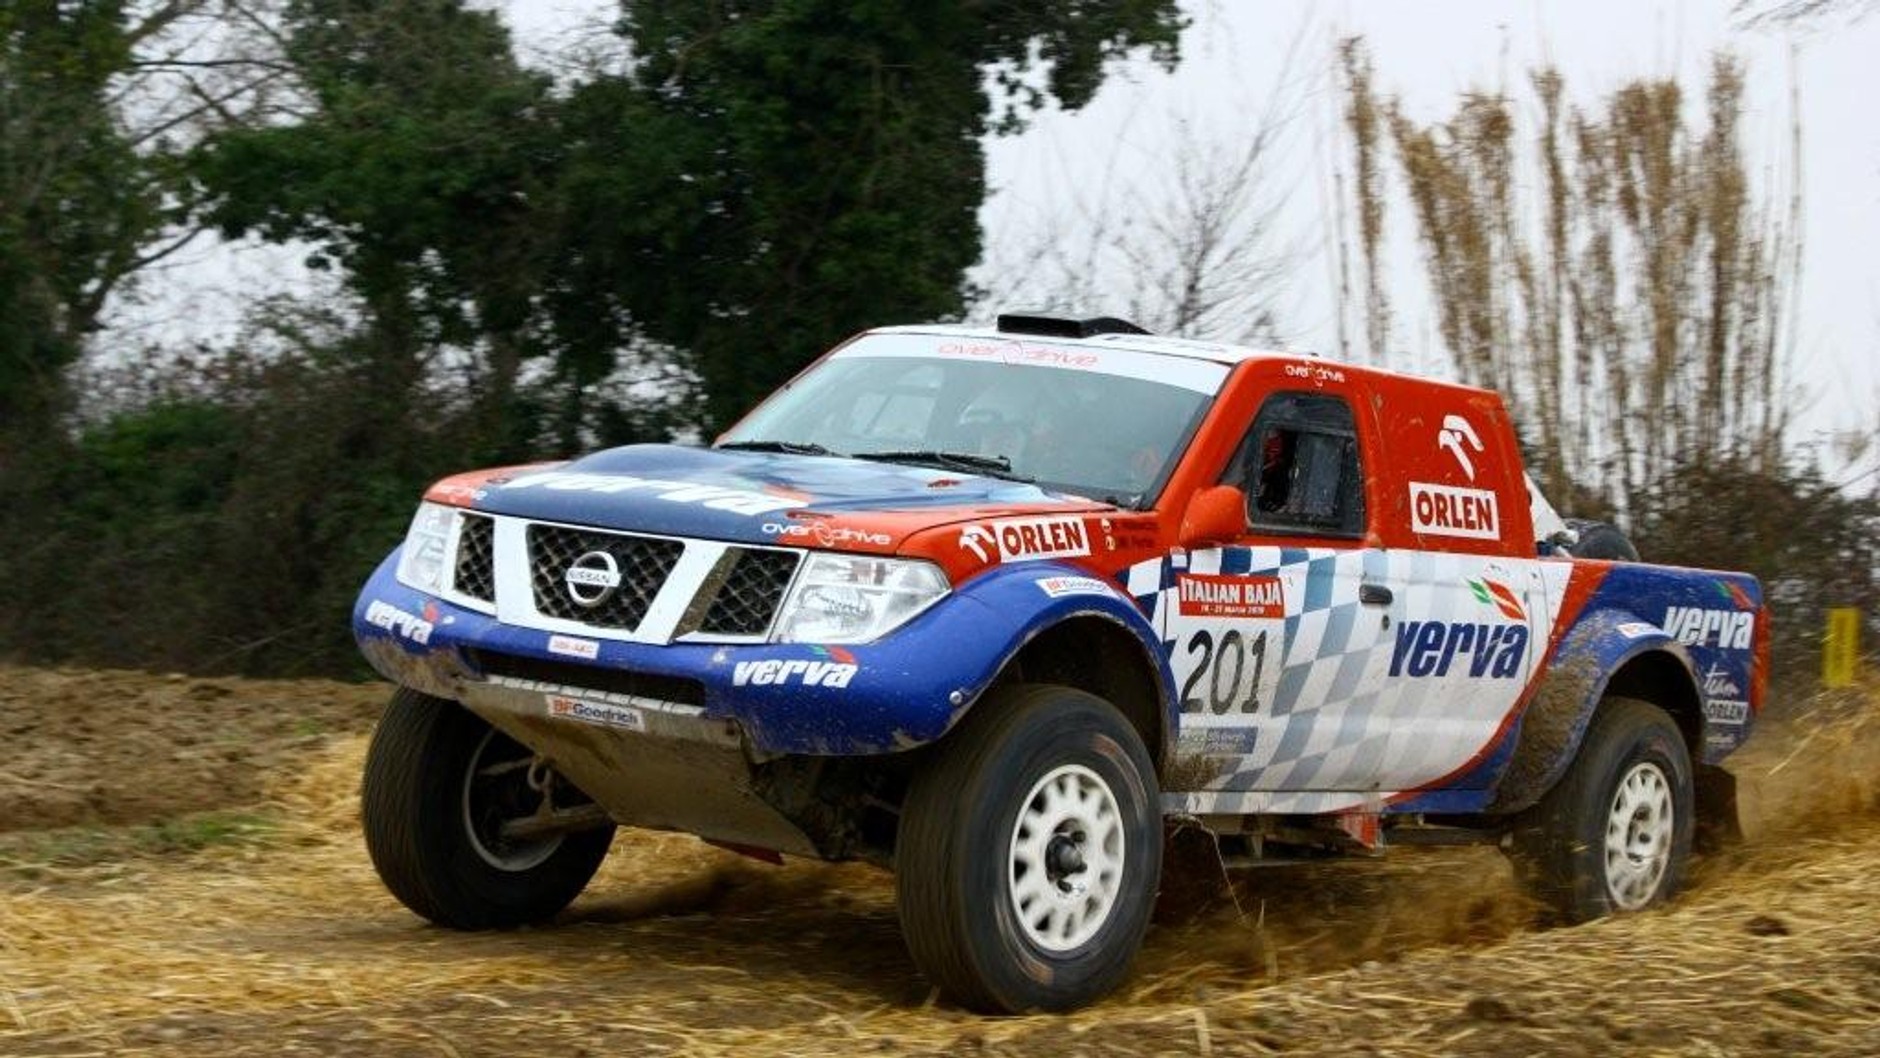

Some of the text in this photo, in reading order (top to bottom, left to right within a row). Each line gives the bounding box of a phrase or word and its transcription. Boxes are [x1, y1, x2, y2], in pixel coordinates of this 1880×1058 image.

[1416, 491, 1494, 531] ORLEN
[1003, 522, 1083, 556] ORLEN
[1180, 577, 1282, 605] ITALIAN BAJA
[365, 599, 434, 645] verva
[1663, 606, 1756, 650] verva
[1388, 620, 1529, 679] verva
[732, 659, 859, 688] verva
[1179, 629, 1267, 716] 201
[553, 698, 639, 725] BFGoodrich
